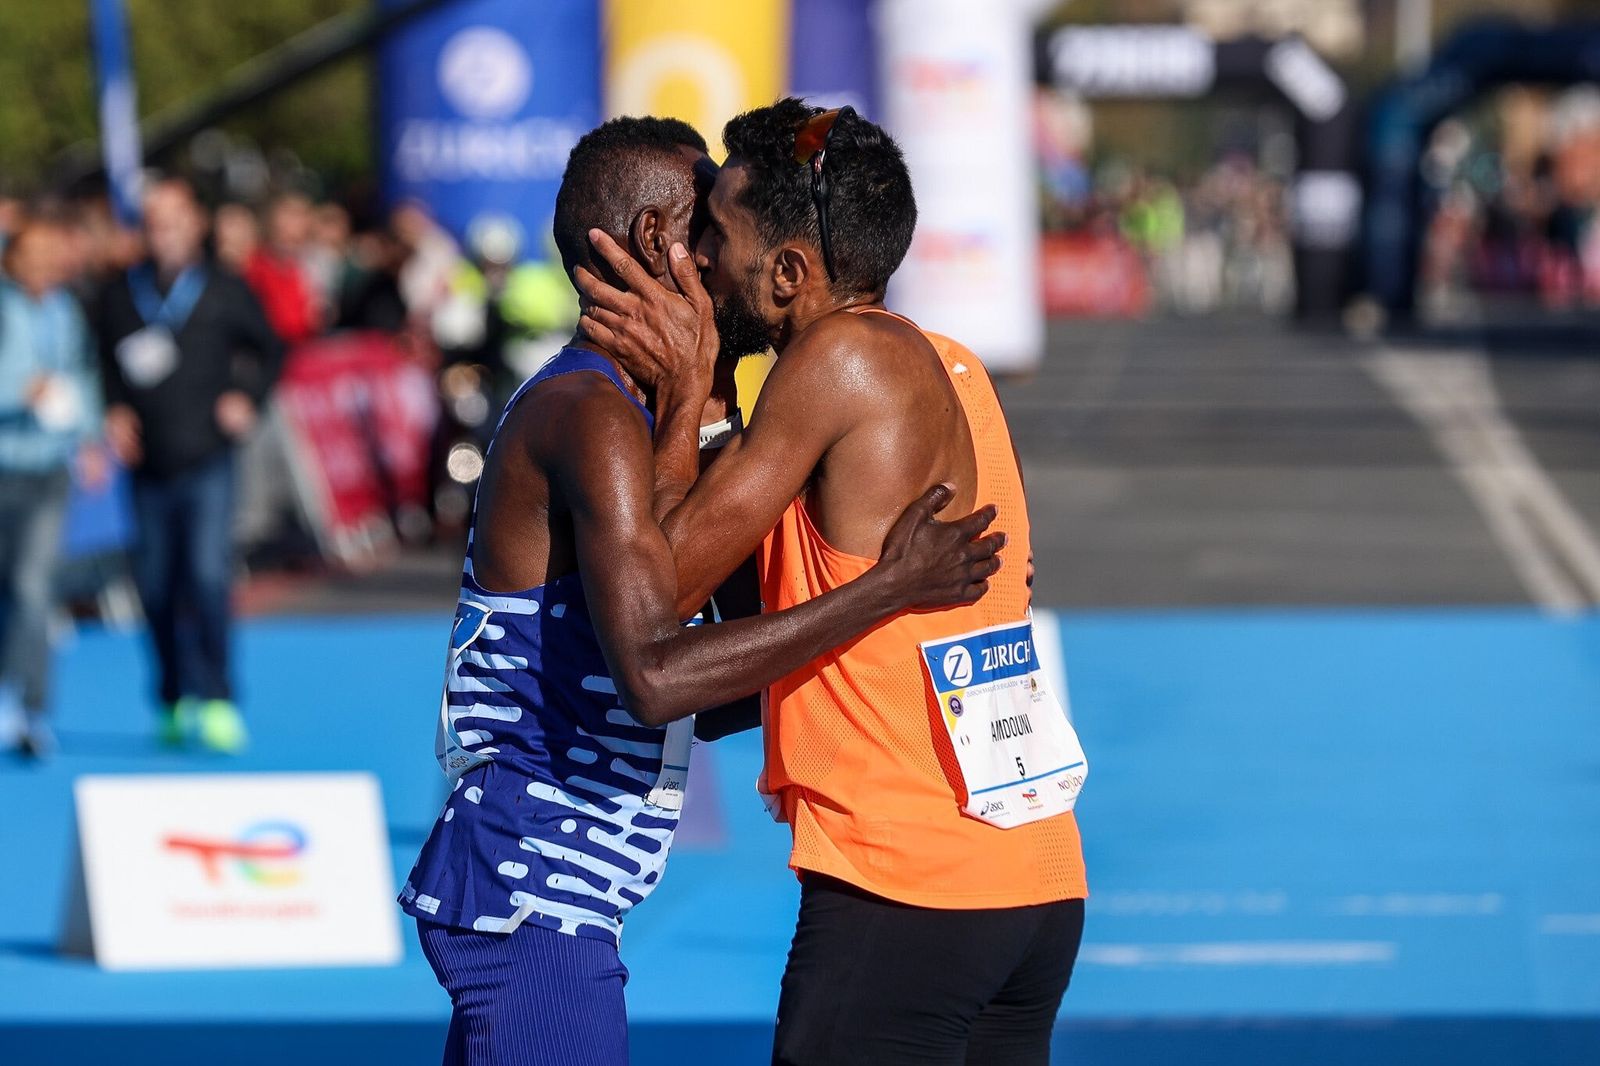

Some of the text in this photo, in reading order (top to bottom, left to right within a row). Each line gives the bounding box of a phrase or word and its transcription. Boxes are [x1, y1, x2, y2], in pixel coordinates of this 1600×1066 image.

[981, 640, 1031, 672] ZURICH
[990, 713, 1033, 742] AMDOUNI
[1015, 756, 1026, 778] 5
